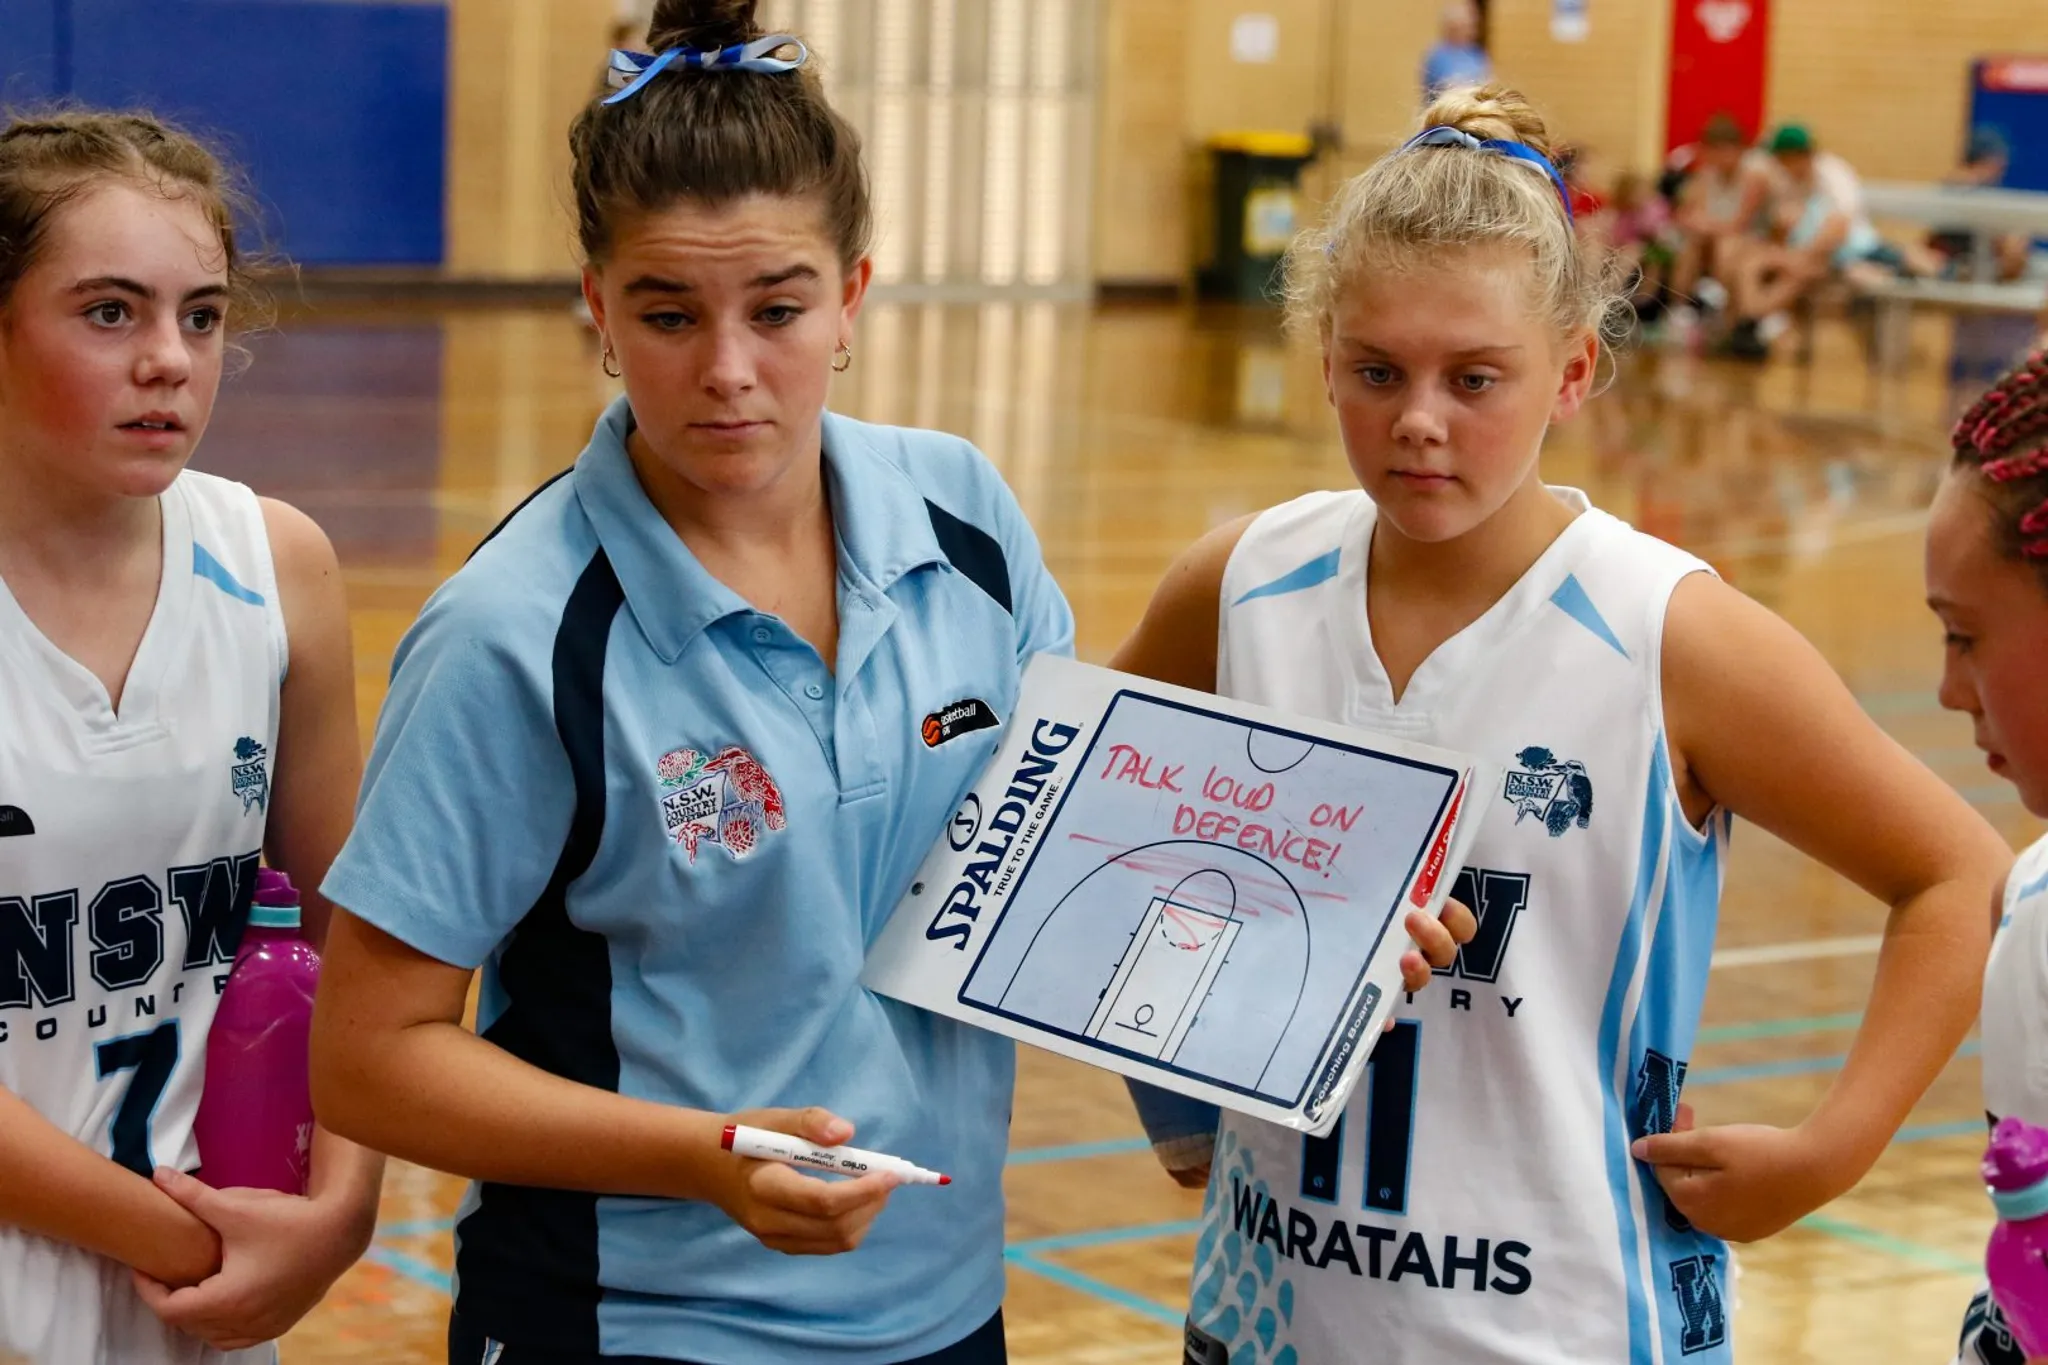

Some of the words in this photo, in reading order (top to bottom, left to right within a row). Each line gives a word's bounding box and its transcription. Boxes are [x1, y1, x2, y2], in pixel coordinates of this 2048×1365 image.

[663, 784, 716, 810] N.S.W.
[667, 797, 717, 822] COUNTRY
[925, 718, 1081, 951] SPALDING
[993, 865, 1016, 897] TRUE
[1011, 848, 1026, 863] TO
[1020, 822, 1039, 844] THE
[1035, 784, 1060, 820] GAME
[1100, 744, 1185, 793] TALK
[1309, 803, 1364, 832] ON
[1172, 803, 1342, 879] DEFENCE!
[0, 849, 261, 1009] NSW
[93, 1017, 182, 1178] 7
[1312, 1043, 1351, 1109] Coaching
[1347, 993, 1374, 1038] Board
[1233, 1177, 1533, 1296] WARATAHS
